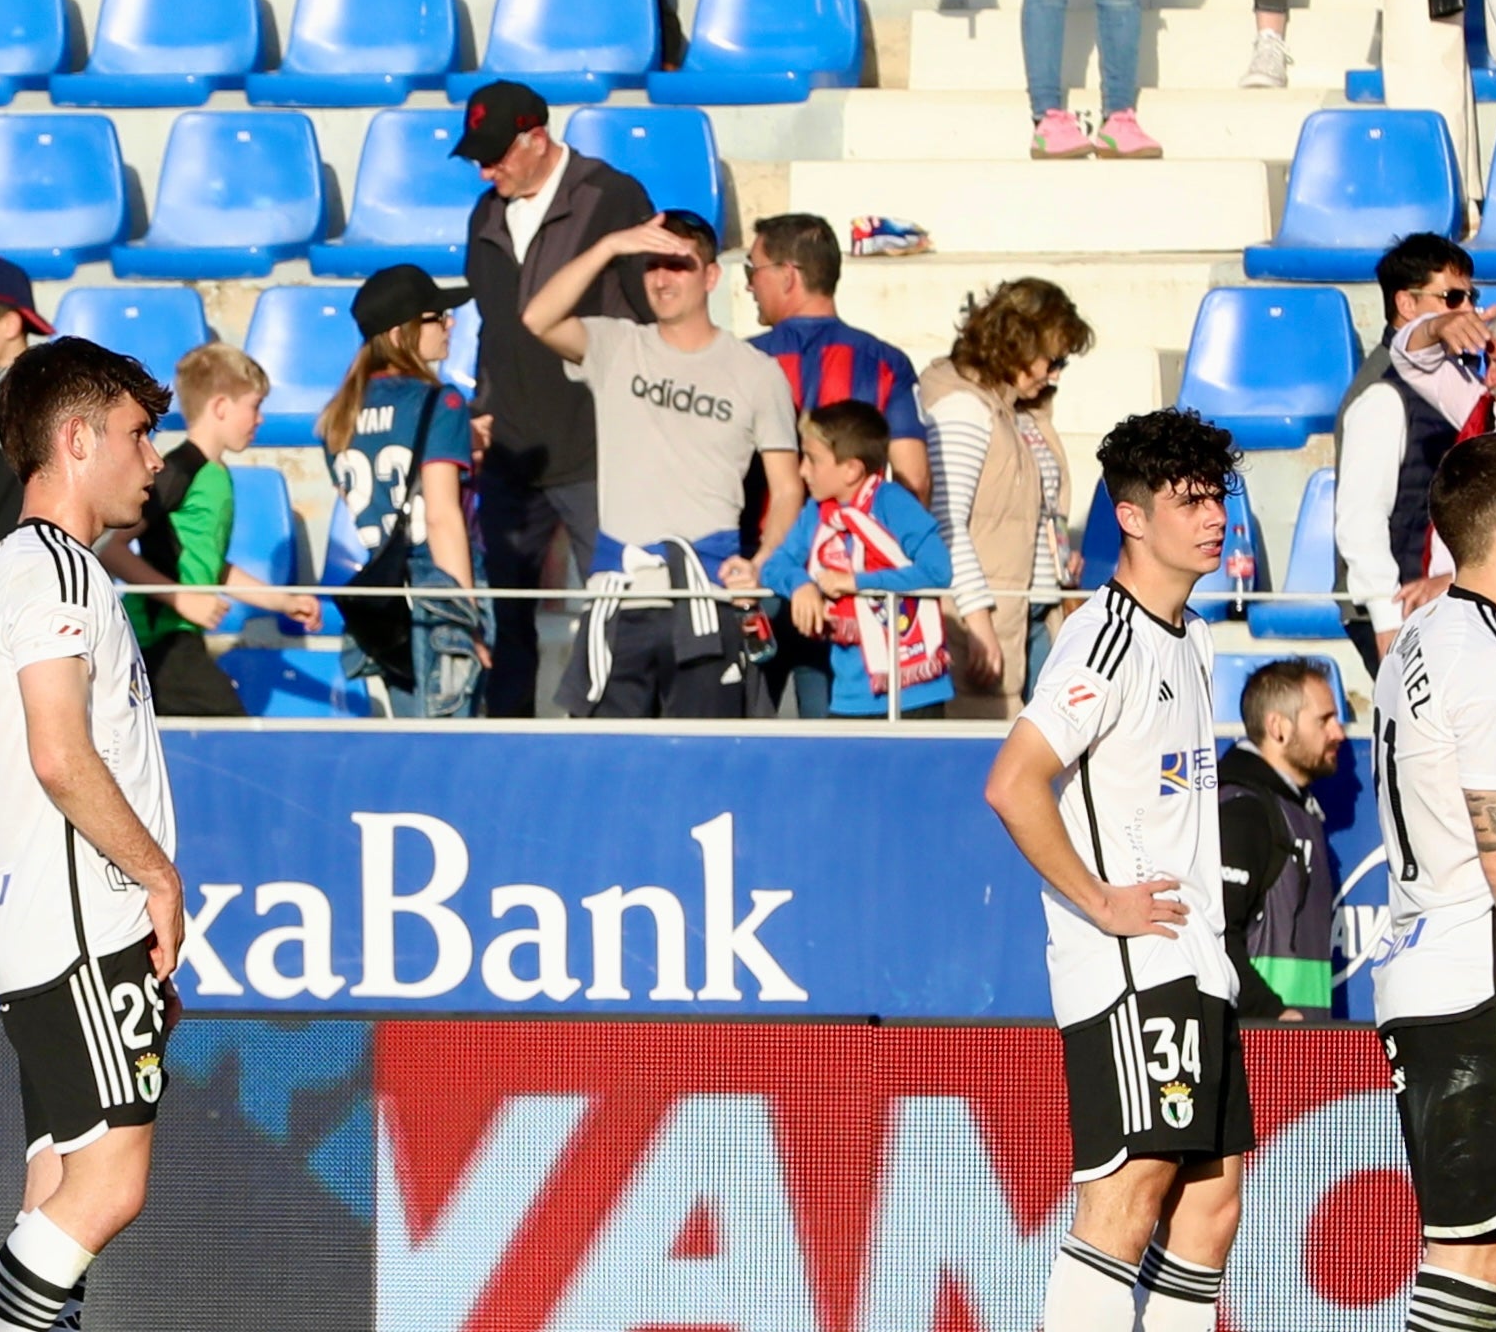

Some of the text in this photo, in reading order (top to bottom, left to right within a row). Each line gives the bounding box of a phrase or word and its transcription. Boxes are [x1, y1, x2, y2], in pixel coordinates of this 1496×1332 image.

[355, 406, 394, 435] VAN
[631, 374, 733, 424] adidas
[1372, 708, 1419, 882] 1
[1141, 1017, 1201, 1085] 34
